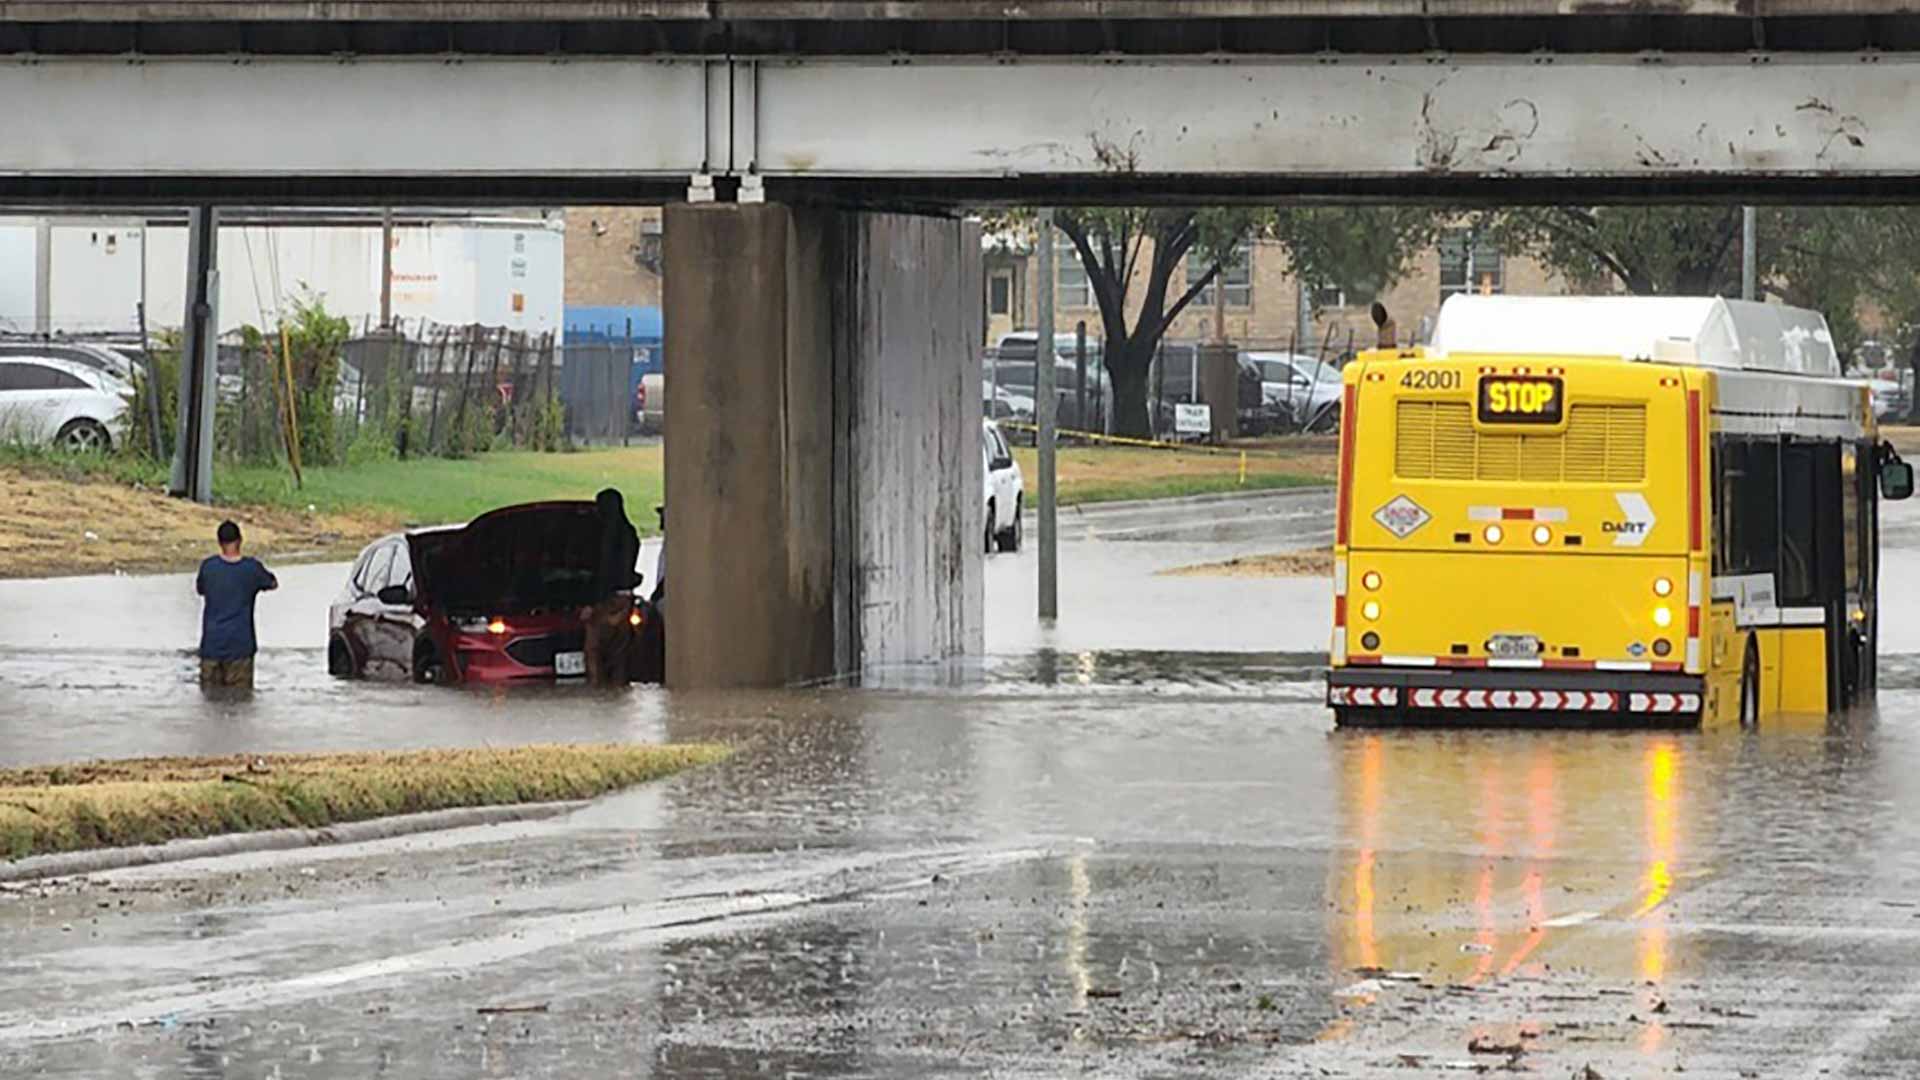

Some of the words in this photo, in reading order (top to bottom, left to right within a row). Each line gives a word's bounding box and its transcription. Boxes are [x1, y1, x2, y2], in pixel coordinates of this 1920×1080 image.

[1400, 370, 1461, 389] 42001
[1489, 380, 1553, 413] STOP
[1601, 521, 1646, 533] DART
